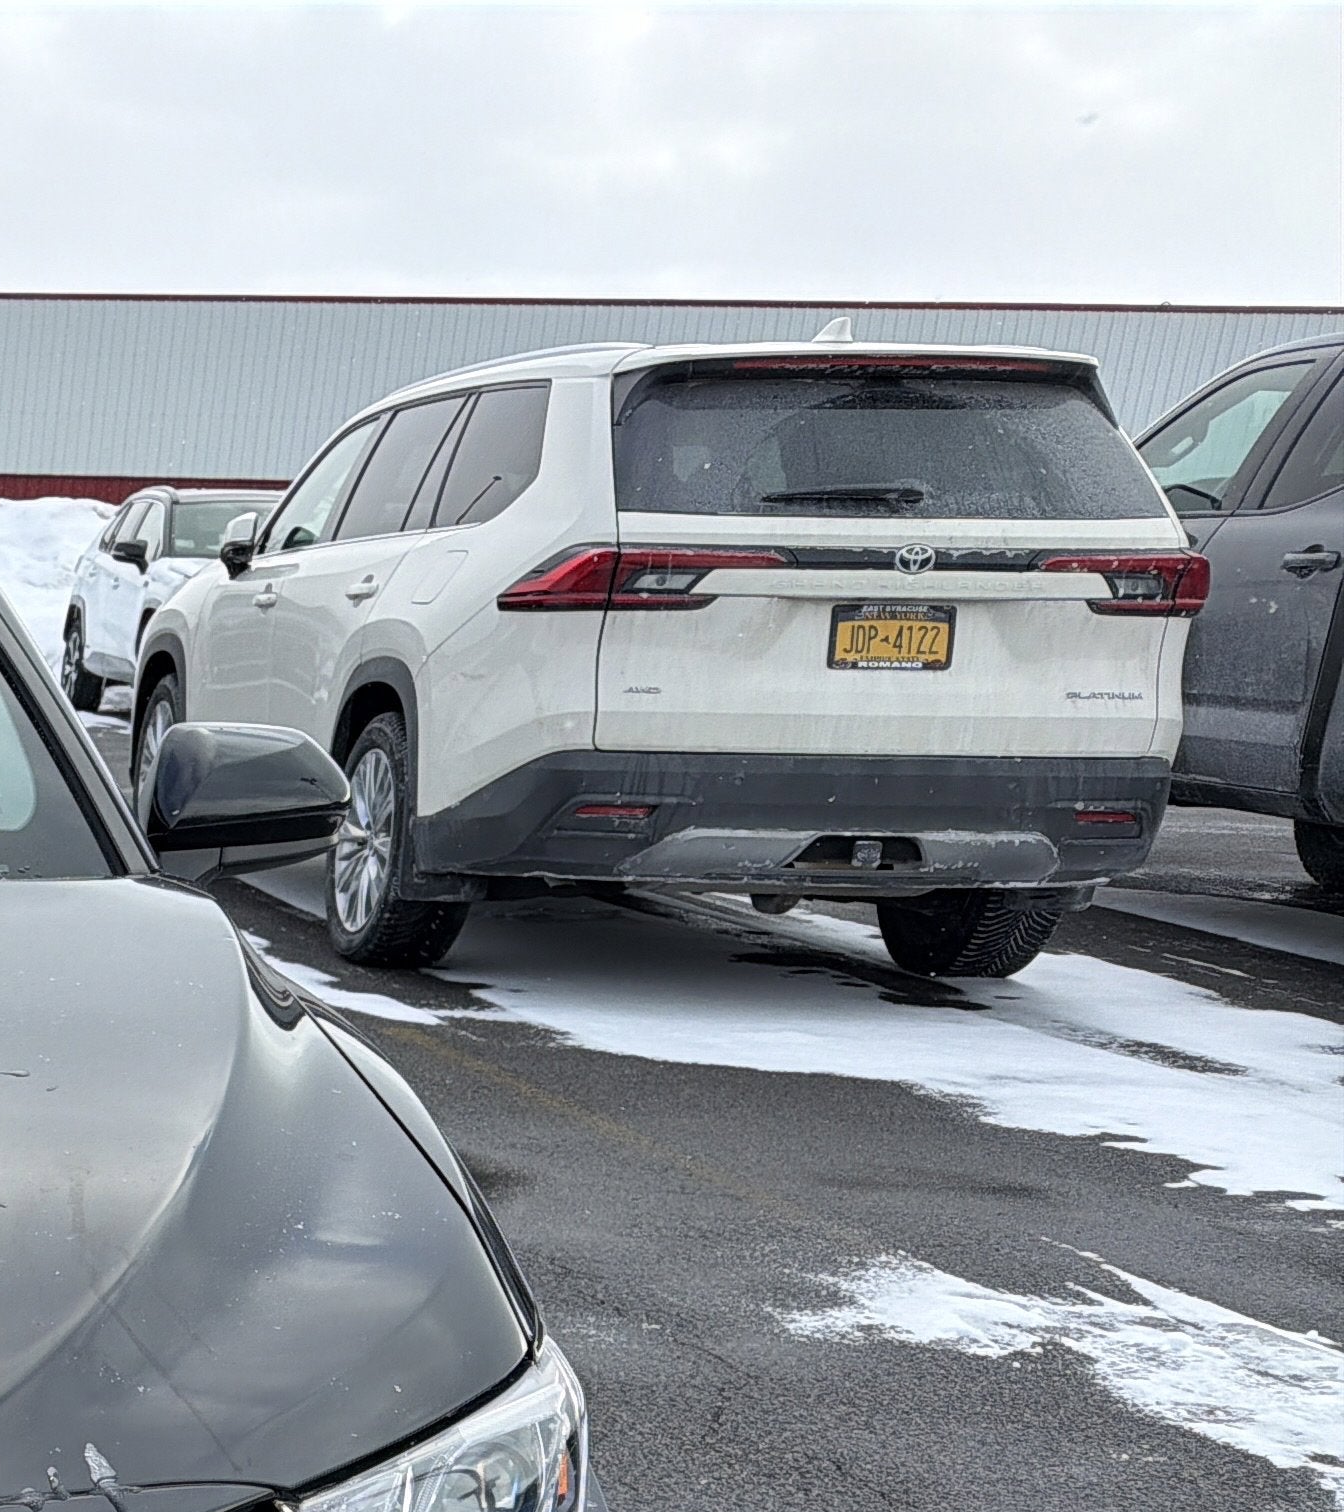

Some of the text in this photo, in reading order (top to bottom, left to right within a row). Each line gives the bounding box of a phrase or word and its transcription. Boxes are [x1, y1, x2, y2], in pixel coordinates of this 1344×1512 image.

[863, 611, 925, 620] NEW YORK
[857, 660, 923, 668] ROMANO
